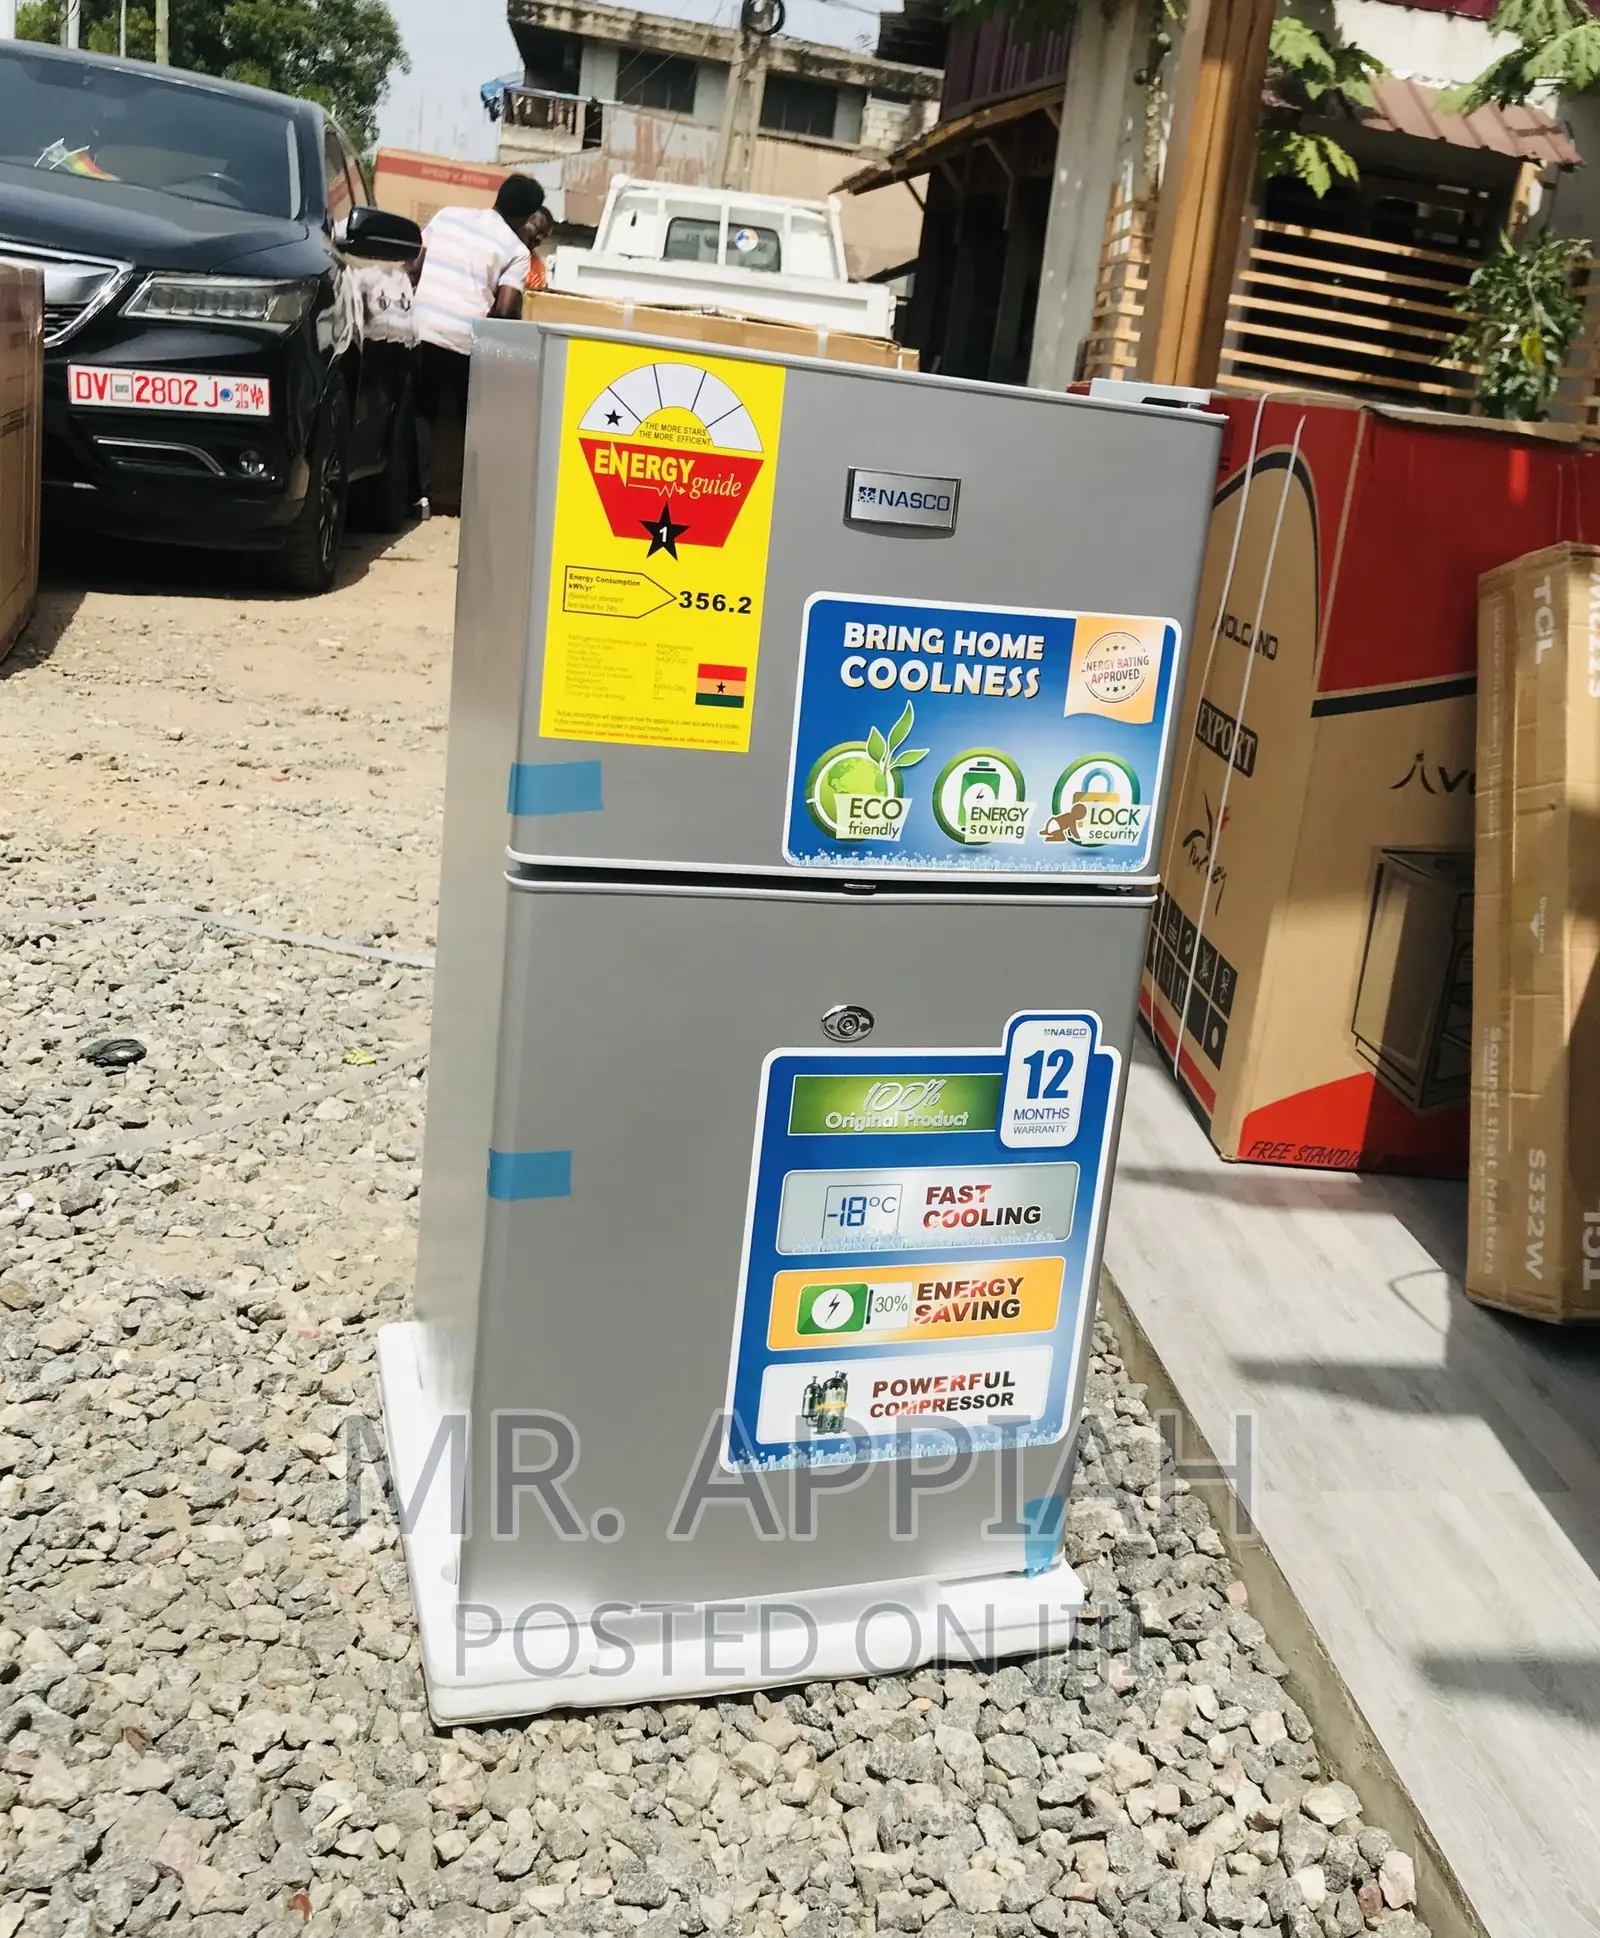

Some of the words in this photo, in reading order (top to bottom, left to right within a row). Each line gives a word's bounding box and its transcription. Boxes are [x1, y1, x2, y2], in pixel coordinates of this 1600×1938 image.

[75, 371, 108, 401] DV
[134, 375, 198, 407] 2802
[203, 380, 218, 408] J
[639, 430, 653, 440] THE
[653, 431, 675, 442] MORE
[676, 434, 712, 446] EFFICIENT
[645, 421, 658, 432] THE
[660, 423, 682, 434] MORE
[683, 425, 707, 437] STARS
[594, 441, 695, 488] ENERGY
[689, 473, 742, 500] guide
[878, 489, 951, 512] NASCO
[658, 526, 668, 543] 1
[569, 573, 594, 583] Energy
[595, 576, 641, 587] Consumption
[678, 590, 752, 615] 356.2
[1534, 575, 1556, 665] TCL
[843, 621, 945, 655] BRING
[952, 630, 1046, 661] HOME
[1081, 659, 1116, 673] ENERGY
[1117, 655, 1150, 669] RATING
[839, 655, 1041, 700] COOLNESS
[1091, 668, 1140, 684] APPROVED
[1198, 706, 1255, 773] EXPORT
[849, 797, 903, 820] ECO
[970, 806, 1029, 821] ENERGY
[1090, 807, 1140, 826] LOCK
[848, 822, 900, 840] friendly
[970, 823, 1025, 839] saving
[1088, 827, 1139, 842] security
[1050, 1028, 1087, 1036] NASCO
[1023, 1048, 1074, 1099] 12
[1487, 1026, 1502, 1108] Sound
[862, 1078, 947, 1112] 100%
[825, 1111, 898, 1132] Original
[904, 1111, 969, 1128] Product
[1013, 1107, 1070, 1121] MONTHS
[1013, 1125, 1067, 1135] WARRANTY
[1247, 1141, 1295, 1160] FREE
[1485, 1116, 1501, 1169] that
[925, 1184, 993, 1206] FAST
[922, 1205, 1042, 1229] COOLING
[1525, 1148, 1547, 1280] S332W
[1482, 1178, 1499, 1276] Matters
[916, 1277, 1025, 1303] ENERGY
[874, 1294, 909, 1314] 30%
[913, 1298, 1021, 1325] SAVING
[872, 1370, 1016, 1399] POWERFUL
[869, 1392, 1014, 1419] COMPRESSOR
